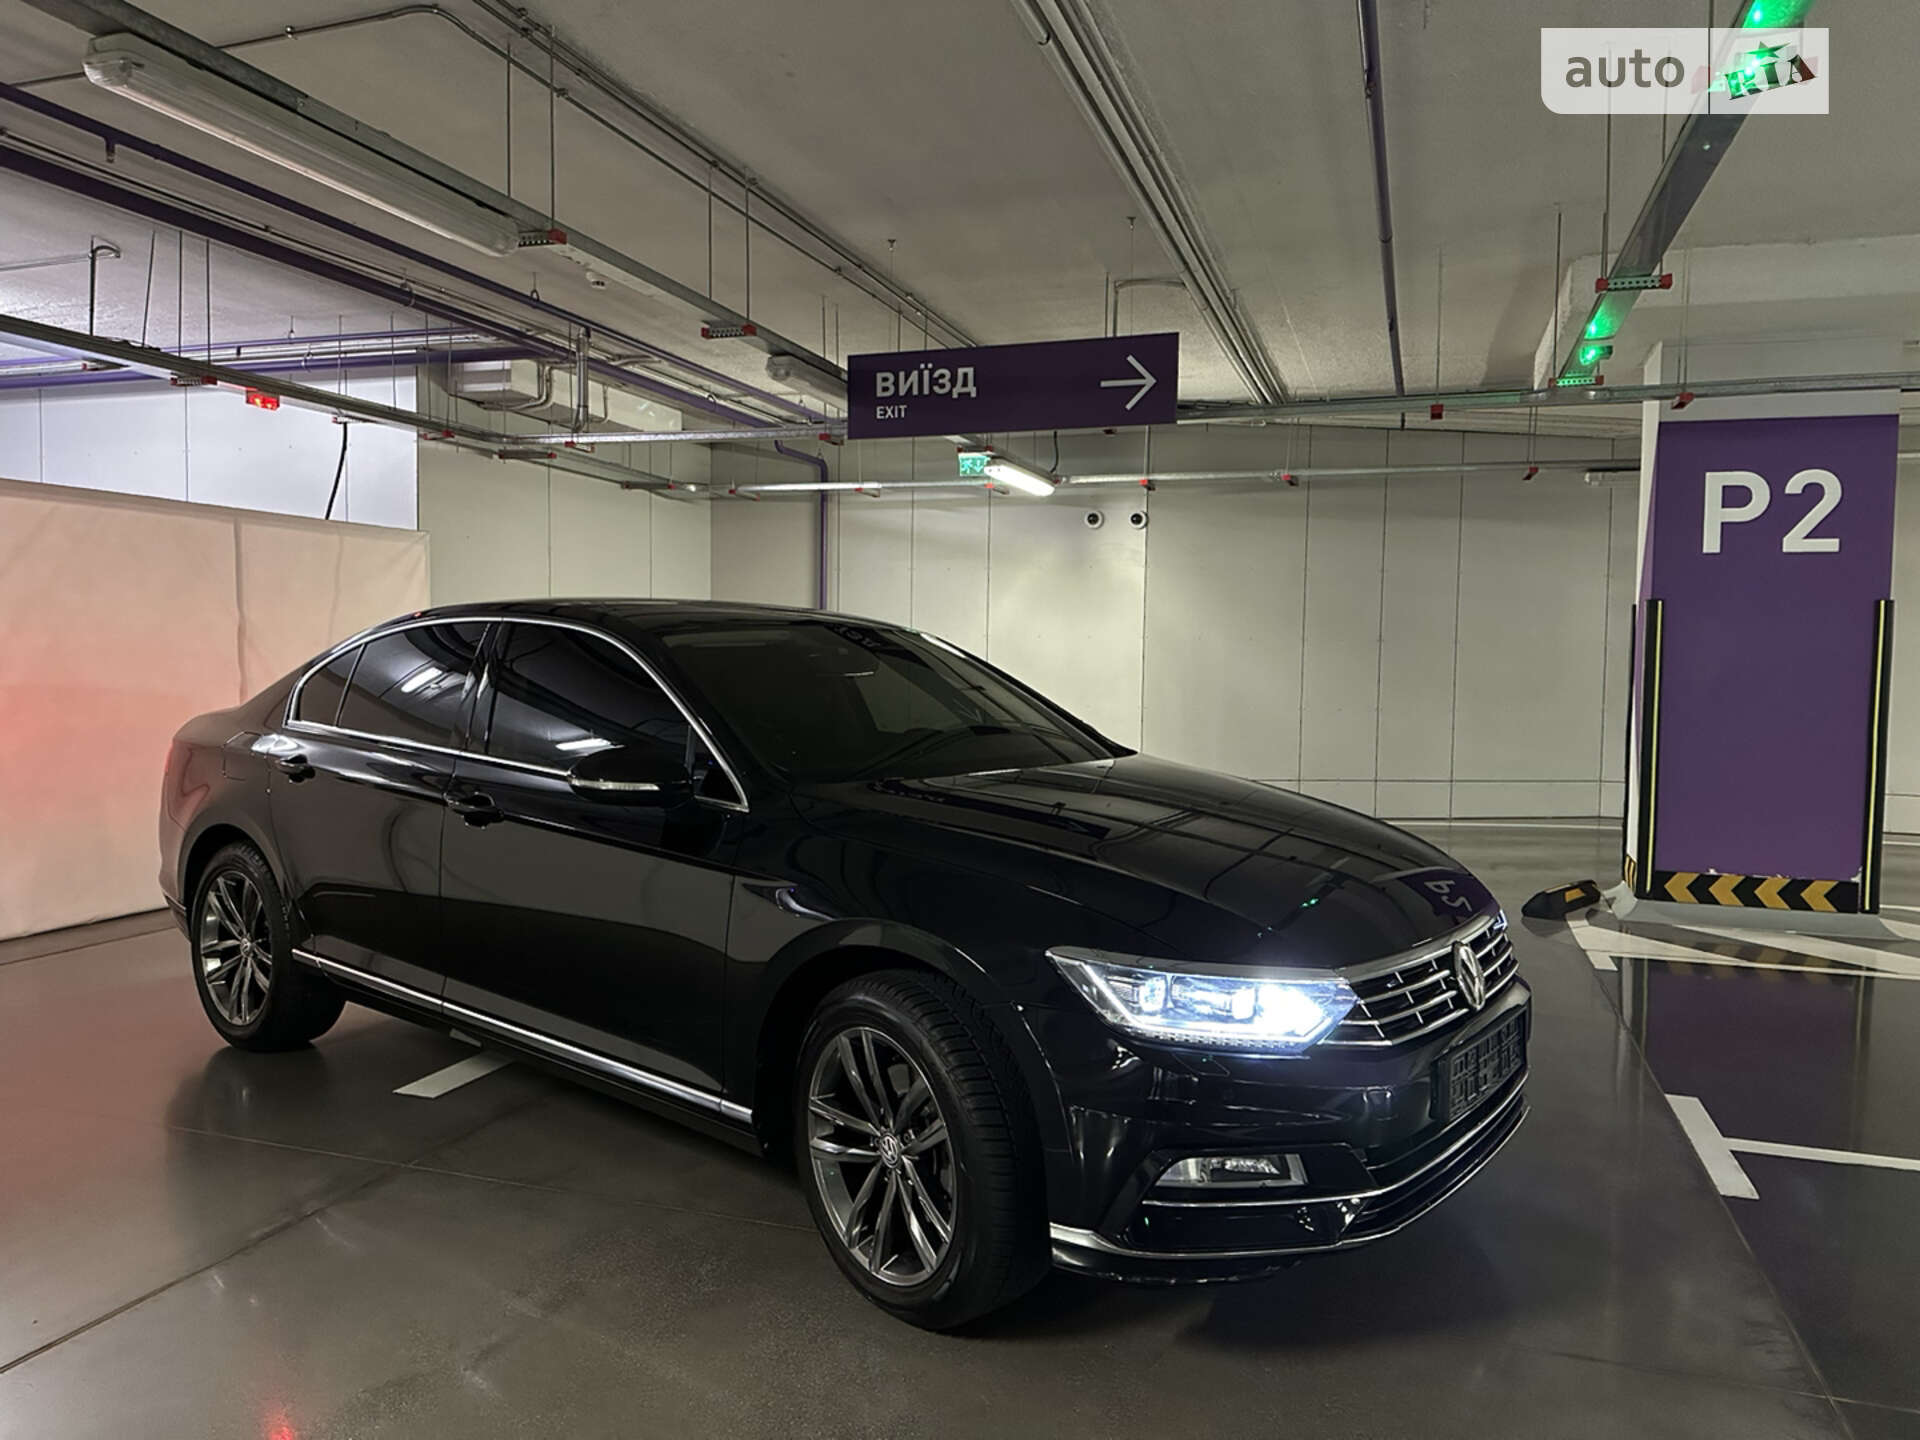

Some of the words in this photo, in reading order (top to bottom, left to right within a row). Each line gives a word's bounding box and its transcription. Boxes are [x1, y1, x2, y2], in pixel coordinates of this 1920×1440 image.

[875, 362, 977, 398] ВИЇЗД
[875, 404, 908, 420] EXIT
[1702, 468, 1842, 554] P2
